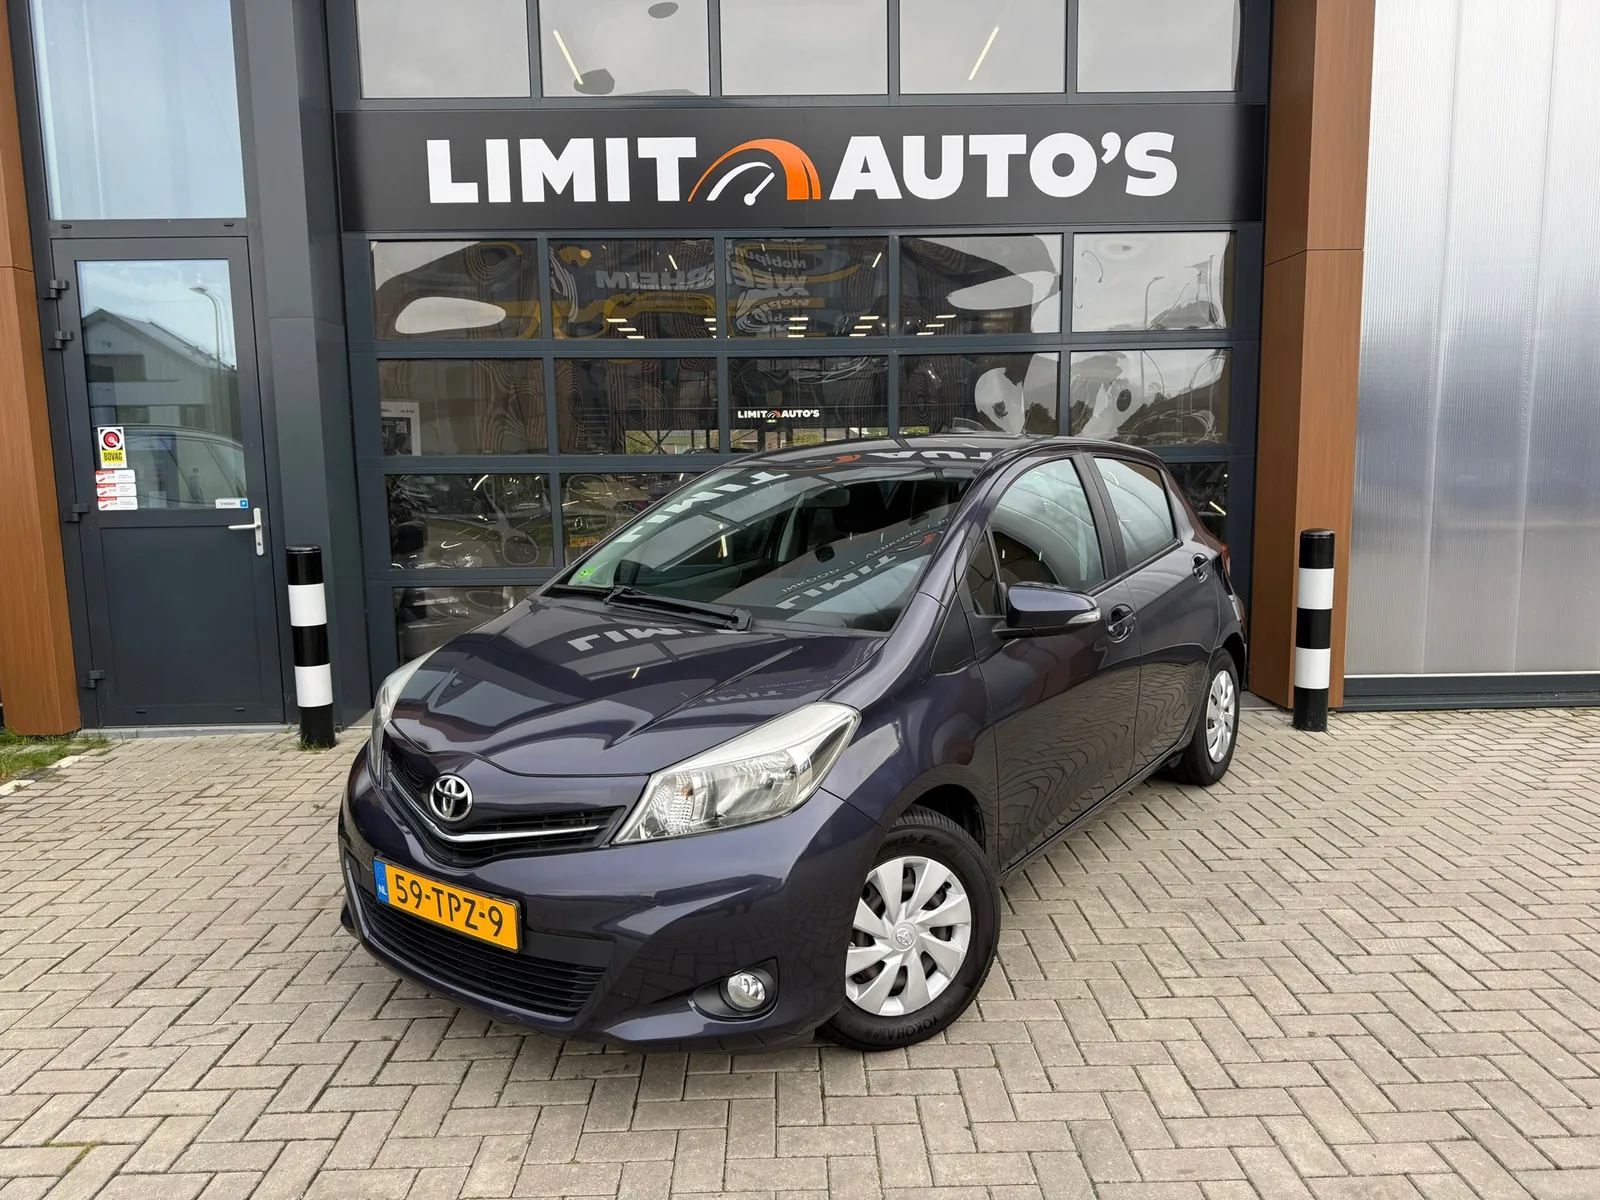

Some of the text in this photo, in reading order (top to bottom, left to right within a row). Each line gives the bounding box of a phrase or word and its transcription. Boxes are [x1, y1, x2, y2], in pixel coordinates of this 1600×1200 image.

[426, 131, 1179, 204] LIMIT AUTO'S
[737, 410, 768, 419] LIMIT
[103, 451, 123, 461] BOVAG
[378, 884, 388, 896] NL
[394, 873, 504, 938] 59-TPZ-9
